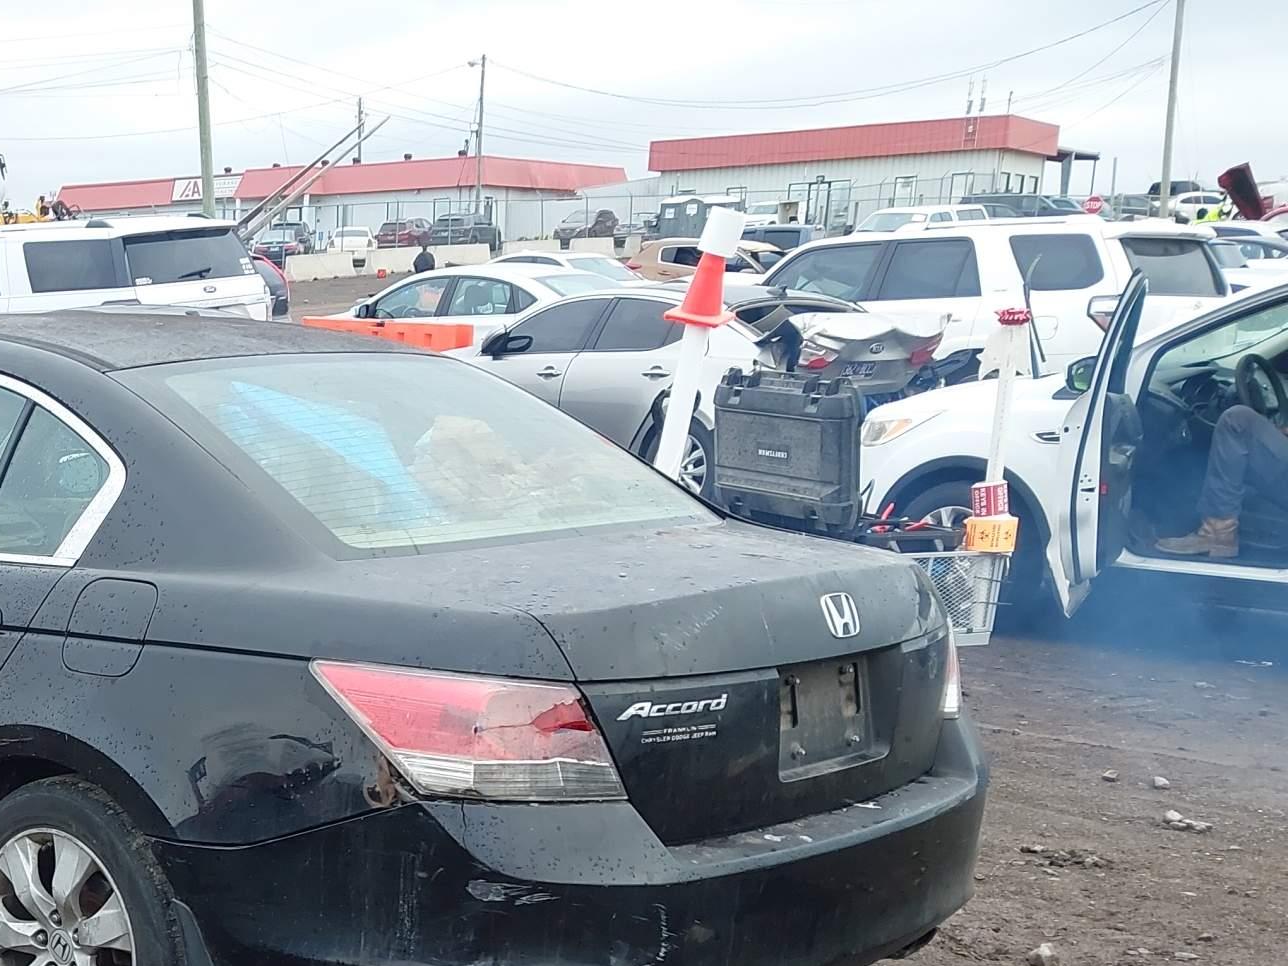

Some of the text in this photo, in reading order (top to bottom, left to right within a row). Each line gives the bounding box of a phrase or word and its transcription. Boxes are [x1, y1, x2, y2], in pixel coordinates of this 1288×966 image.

[1086, 200, 1102, 210] STOP
[616, 693, 728, 721] Accord
[663, 726, 698, 735] FRANKLIN
[640, 736, 671, 744] CHRYSLER
